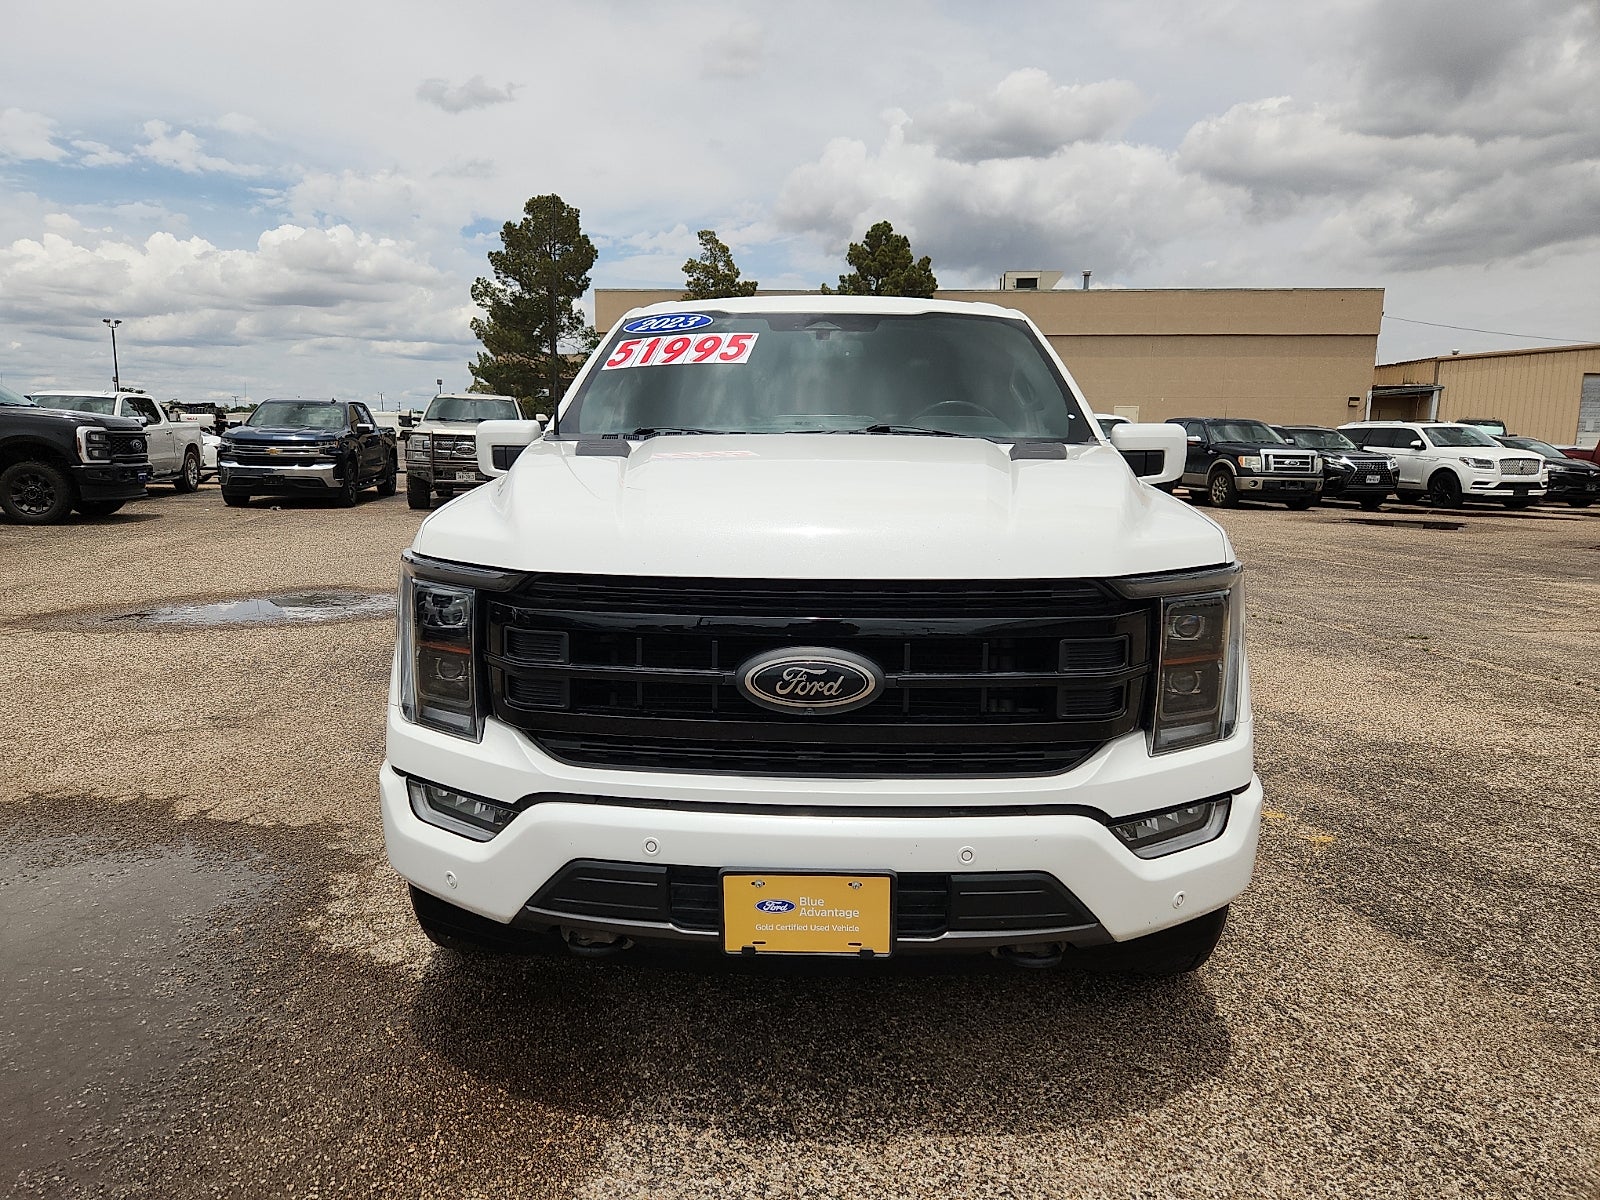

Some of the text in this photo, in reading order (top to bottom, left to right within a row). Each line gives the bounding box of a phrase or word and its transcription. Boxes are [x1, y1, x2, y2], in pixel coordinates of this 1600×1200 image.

[634, 315, 702, 332] 2023
[606, 334, 755, 368] 51995
[775, 666, 845, 696] Ford
[762, 900, 789, 913] Ford
[799, 897, 825, 907] Blue
[799, 907, 860, 919] Advantage
[755, 923, 860, 933] Gold Certified Used Vehicle
